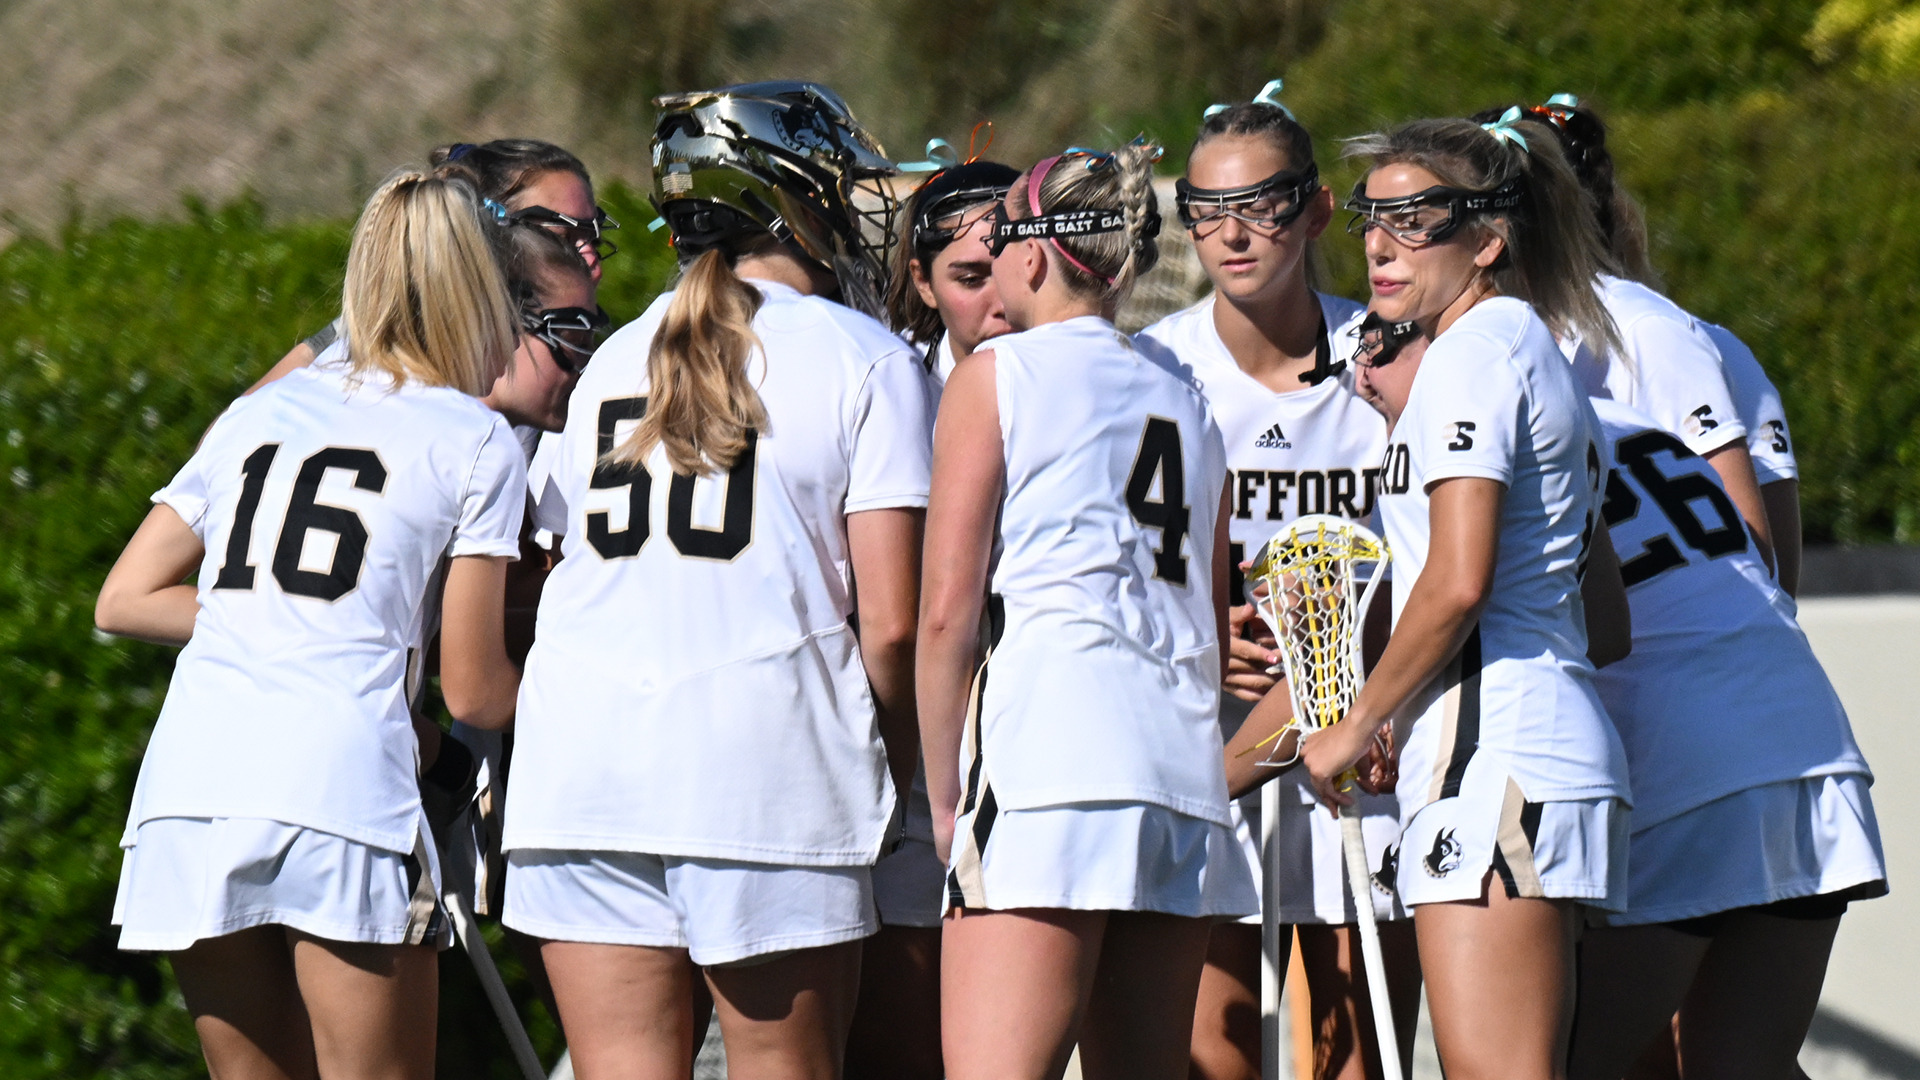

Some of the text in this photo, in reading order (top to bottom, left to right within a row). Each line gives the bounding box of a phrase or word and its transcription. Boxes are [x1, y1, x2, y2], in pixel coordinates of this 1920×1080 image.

[1017, 222, 1049, 235] GAIT
[1054, 219, 1094, 234] GAIT
[1393, 321, 1413, 335] IT
[1255, 438, 1292, 449] adidas
[1448, 421, 1476, 451] S
[1767, 419, 1789, 454] S
[584, 393, 762, 563] 50
[1228, 466, 1382, 520] FFOR
[211, 441, 390, 603] 16
[1124, 413, 1192, 589] 4
[1601, 428, 1748, 588] 26
